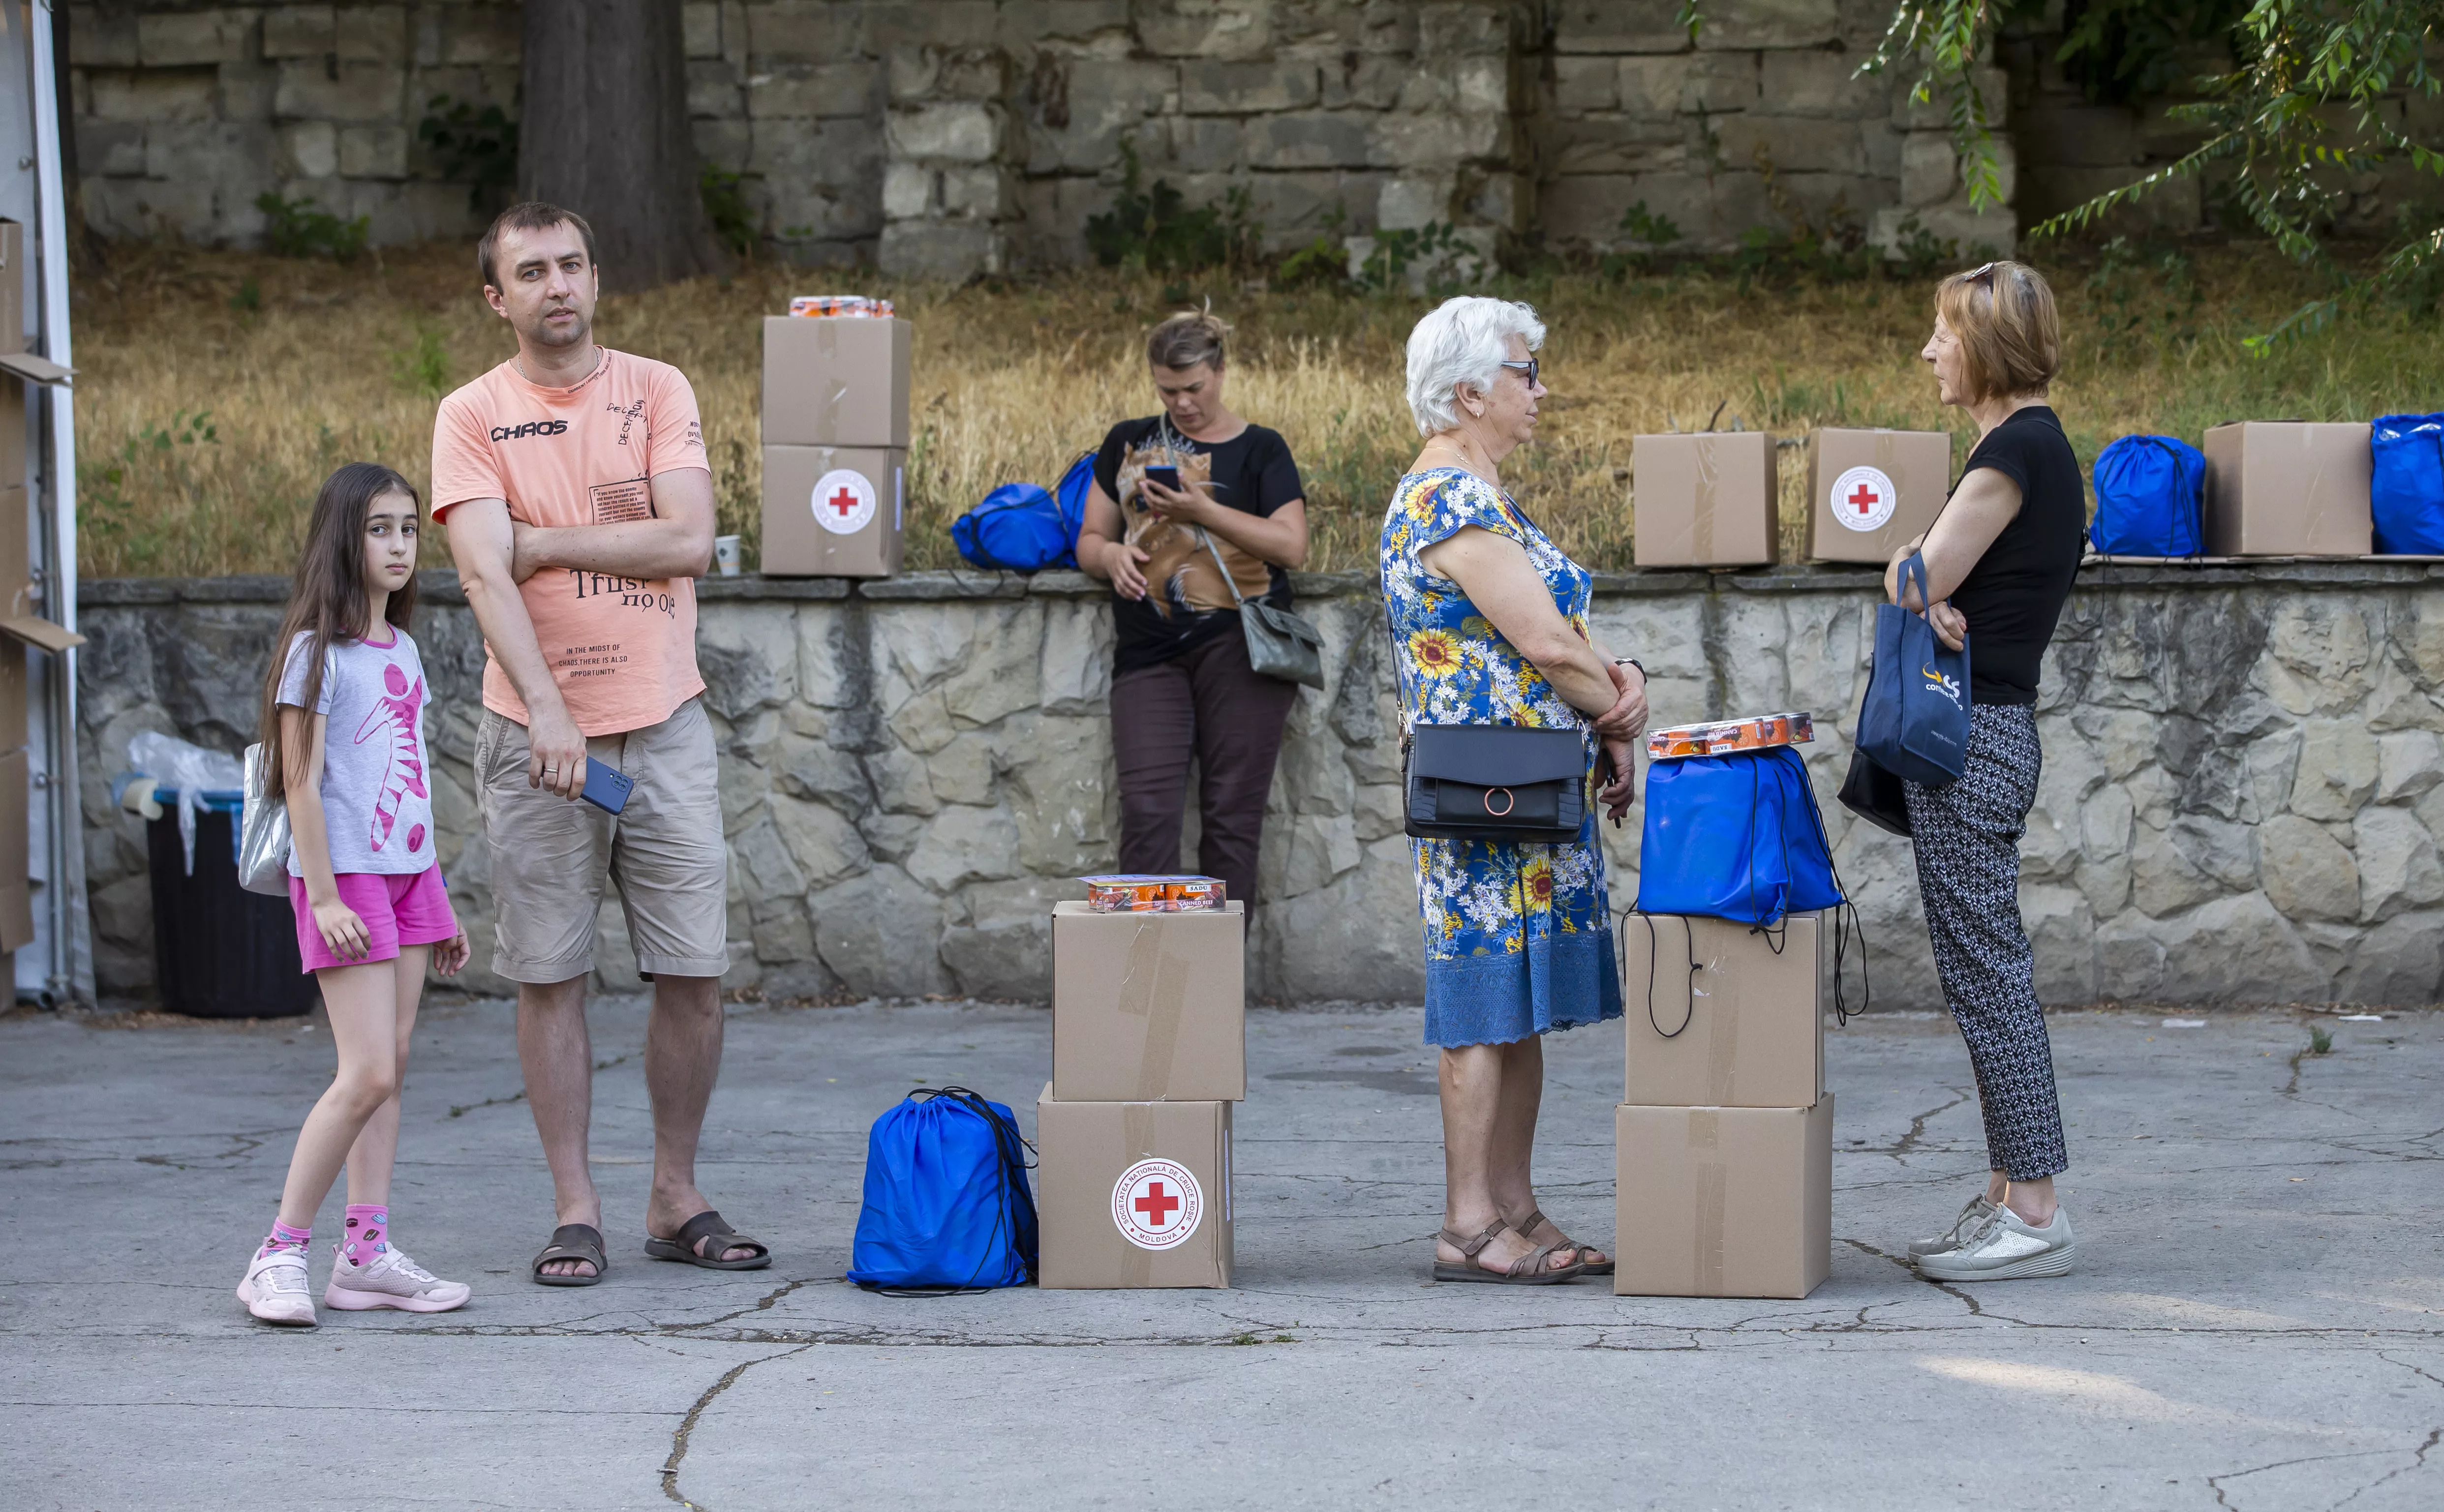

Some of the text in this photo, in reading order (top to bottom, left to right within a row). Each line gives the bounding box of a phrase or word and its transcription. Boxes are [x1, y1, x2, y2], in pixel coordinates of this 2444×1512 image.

[568, 383, 586, 393] CURRENT
[490, 420, 568, 442] CHAOS
[621, 592, 654, 612] no
[589, 644, 610, 653] MIDST
[570, 668, 615, 677] OPPORTUNITY
[1118, 1182, 1130, 1224] SOCIETATEA
[1168, 1169, 1179, 1177] DE
[1179, 1176, 1194, 1198] CRUCE
[1139, 1233, 1177, 1242] MOLDOVA
